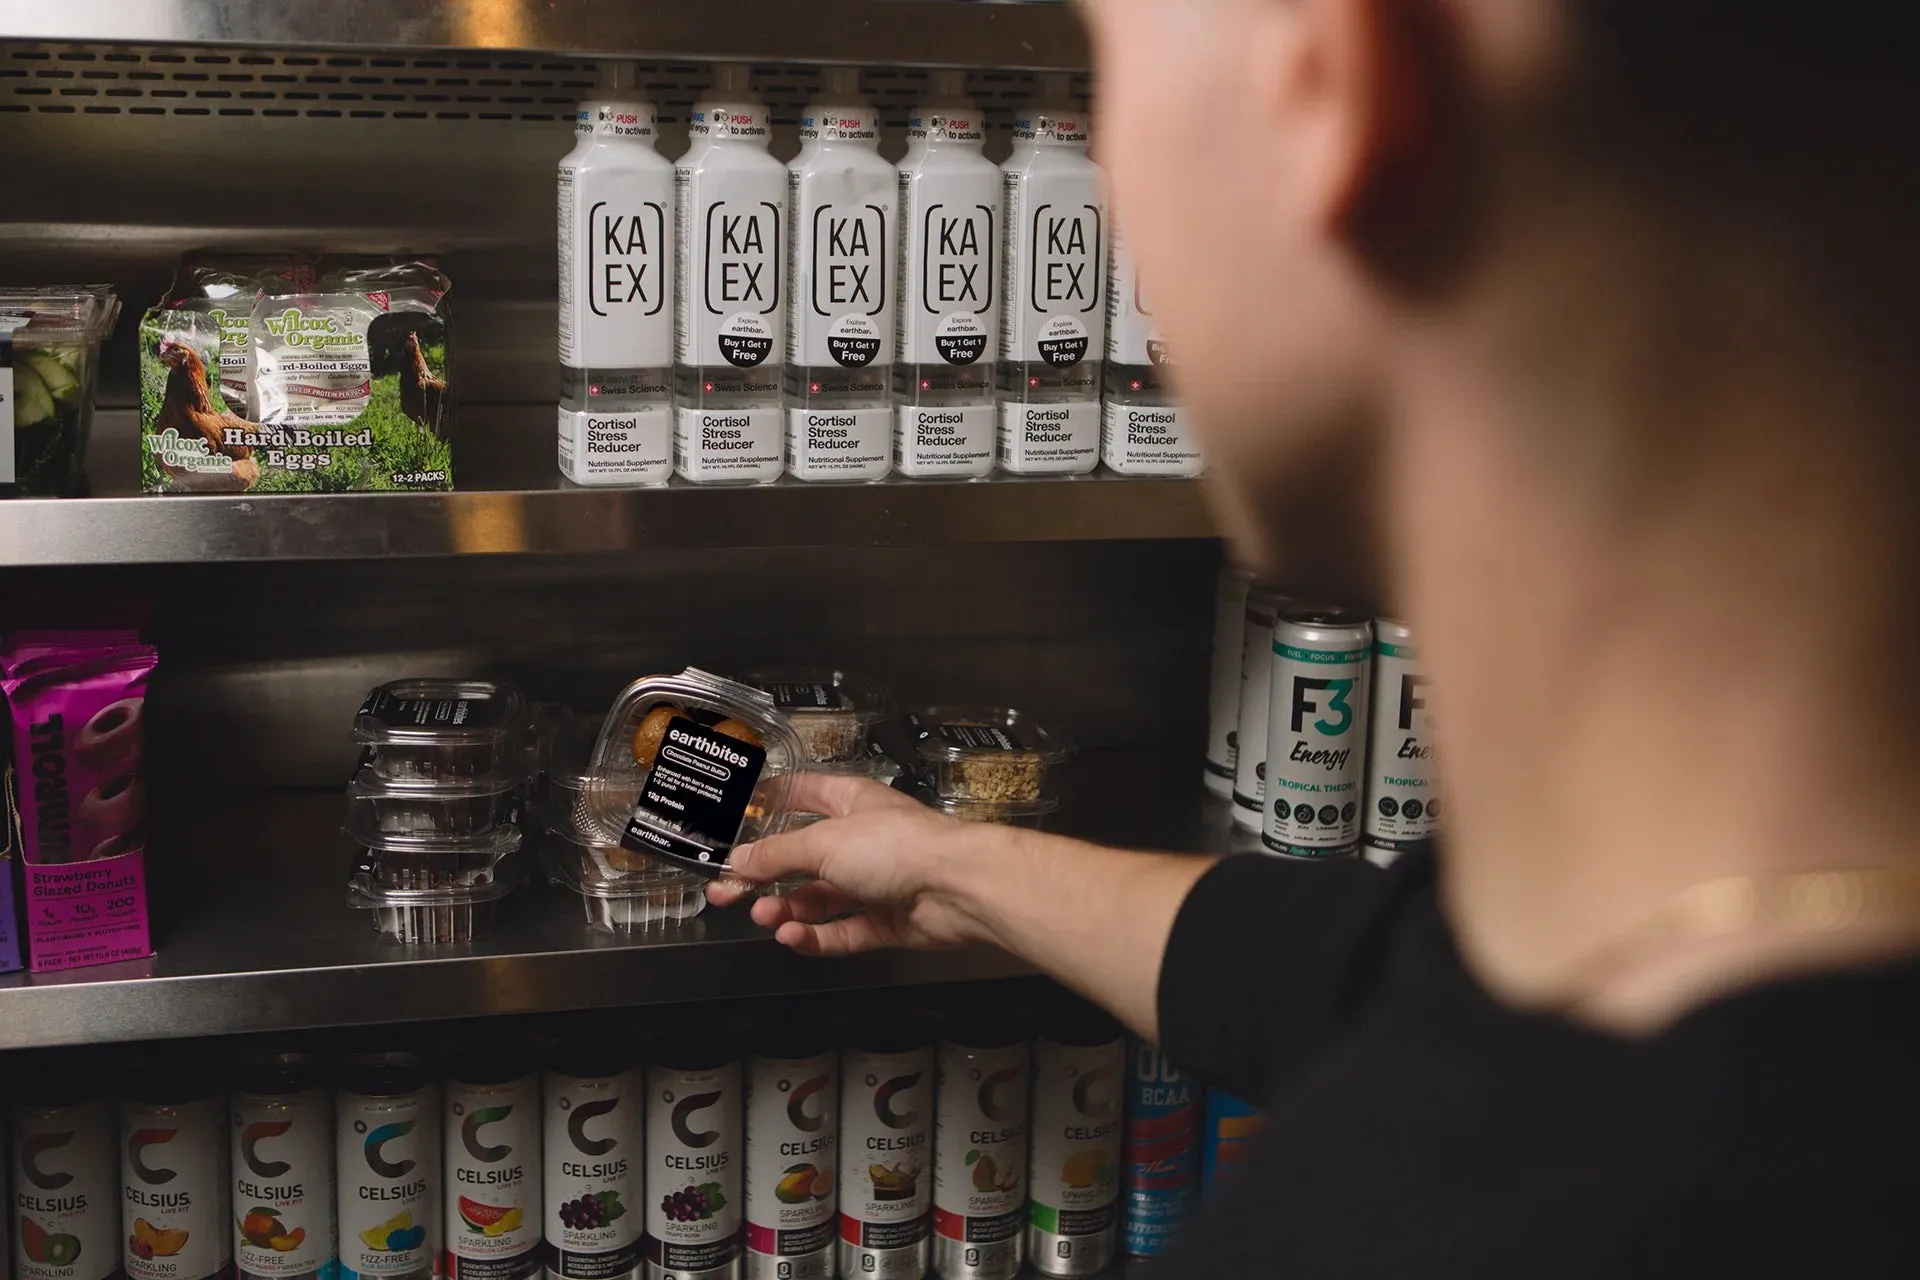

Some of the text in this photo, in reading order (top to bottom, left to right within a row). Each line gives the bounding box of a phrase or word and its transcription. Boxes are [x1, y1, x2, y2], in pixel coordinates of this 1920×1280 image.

[617, 115, 637, 124] PUSH
[732, 115, 752, 124] PUSH
[840, 120, 860, 128] PUSH
[949, 120, 969, 129] PUSH
[615, 126, 622, 134] to
[1057, 121, 1076, 131] PUSH
[949, 131, 956, 139] to
[605, 216, 648, 254] KA
[722, 216, 763, 254] KA
[830, 218, 869, 256] KA
[940, 218, 978, 255] KA
[1048, 218, 1086, 254] KA
[605, 264, 648, 302] EX
[722, 263, 763, 301] EX
[830, 265, 869, 303] EX
[939, 264, 978, 301] EX
[1046, 263, 1084, 300] EX
[265, 309, 336, 335] Wilcox
[286, 332, 363, 350] Organic
[724, 339, 738, 348] Buy
[833, 341, 847, 349] Buy
[733, 350, 757, 360] Free
[842, 351, 865, 361] Free
[950, 350, 973, 358] Free
[1053, 353, 1075, 362] Free
[273, 362, 368, 371] rd-Boiled Eggs
[601, 385, 665, 394] Swiss Science
[715, 384, 740, 392] Swiss
[822, 383, 883, 392] Swiss Science
[314, 390, 338, 398] PROTEIN
[809, 416, 856, 426] Cortisol
[919, 413, 963, 423] Cortisol
[1026, 410, 1069, 420] Cortisol
[1129, 412, 1175, 423] Cortisol
[588, 419, 636, 429] Cortisol
[703, 416, 750, 427] Cortisol
[1026, 422, 1061, 431] Stress
[702, 428, 741, 438] Stress
[808, 428, 847, 437] Stress
[917, 424, 954, 434] Stress
[1128, 423, 1166, 434] Stress
[147, 429, 208, 455] Wilcox
[223, 428, 372, 447] Hard Boiled
[588, 431, 627, 441] Stress
[917, 436, 967, 446] Reducer
[1025, 433, 1072, 442] Reducer
[1128, 434, 1178, 445] Reducer
[588, 442, 641, 453] Reducer
[702, 439, 754, 450] Reducer
[808, 439, 860, 449] Reducer
[164, 451, 232, 469] Organic
[268, 450, 331, 469] Eggs
[627, 459, 667, 467] Supplement
[392, 471, 445, 483] 12-2 PACKS
[1310, 653, 1335, 661] FOCUS
[1291, 675, 1355, 736] F3
[669, 729, 749, 768] earthbites
[1290, 740, 1351, 770] Energy
[666, 749, 727, 777] Chocolate Peanut Butter
[657, 765, 718, 794] Enhanced with mane
[1278, 777, 1322, 793] TROPICAL
[30, 713, 70, 864] UMROLL
[655, 772, 666, 780] MCT
[685, 781, 697, 791] brain
[698, 787, 721, 802] protecting
[661, 781, 676, 791] punch
[661, 796, 684, 811] Protein
[33, 869, 112, 884] Strawberry
[34, 876, 136, 896] Glazed Donuts
[107, 896, 135, 909] 200
[1142, 1086, 1189, 1106] BCAA
[867, 1131, 925, 1150] CELSIUS
[665, 1152, 729, 1170] CELSIUS
[562, 1159, 627, 1178] CELSIUS
[457, 1166, 522, 1184] CELSIUS
[238, 1180, 303, 1201] CELSIUS
[359, 1180, 426, 1201] CELSIUS
[18, 1192, 86, 1213] CELSIUS
[126, 1186, 190, 1208] CELSIUS
[865, 1200, 914, 1212] SPARKLING
[665, 1221, 718, 1233] SPARKLING
[563, 1229, 616, 1241] SPARKLING
[458, 1236, 512, 1249] SPARKLING
[240, 1249, 284, 1265] FIZZ-FREE
[360, 1254, 411, 1264] FIZZ-FREE
[128, 1255, 177, 1272] SPARKLING
[21, 1264, 73, 1277] SPARKLING
